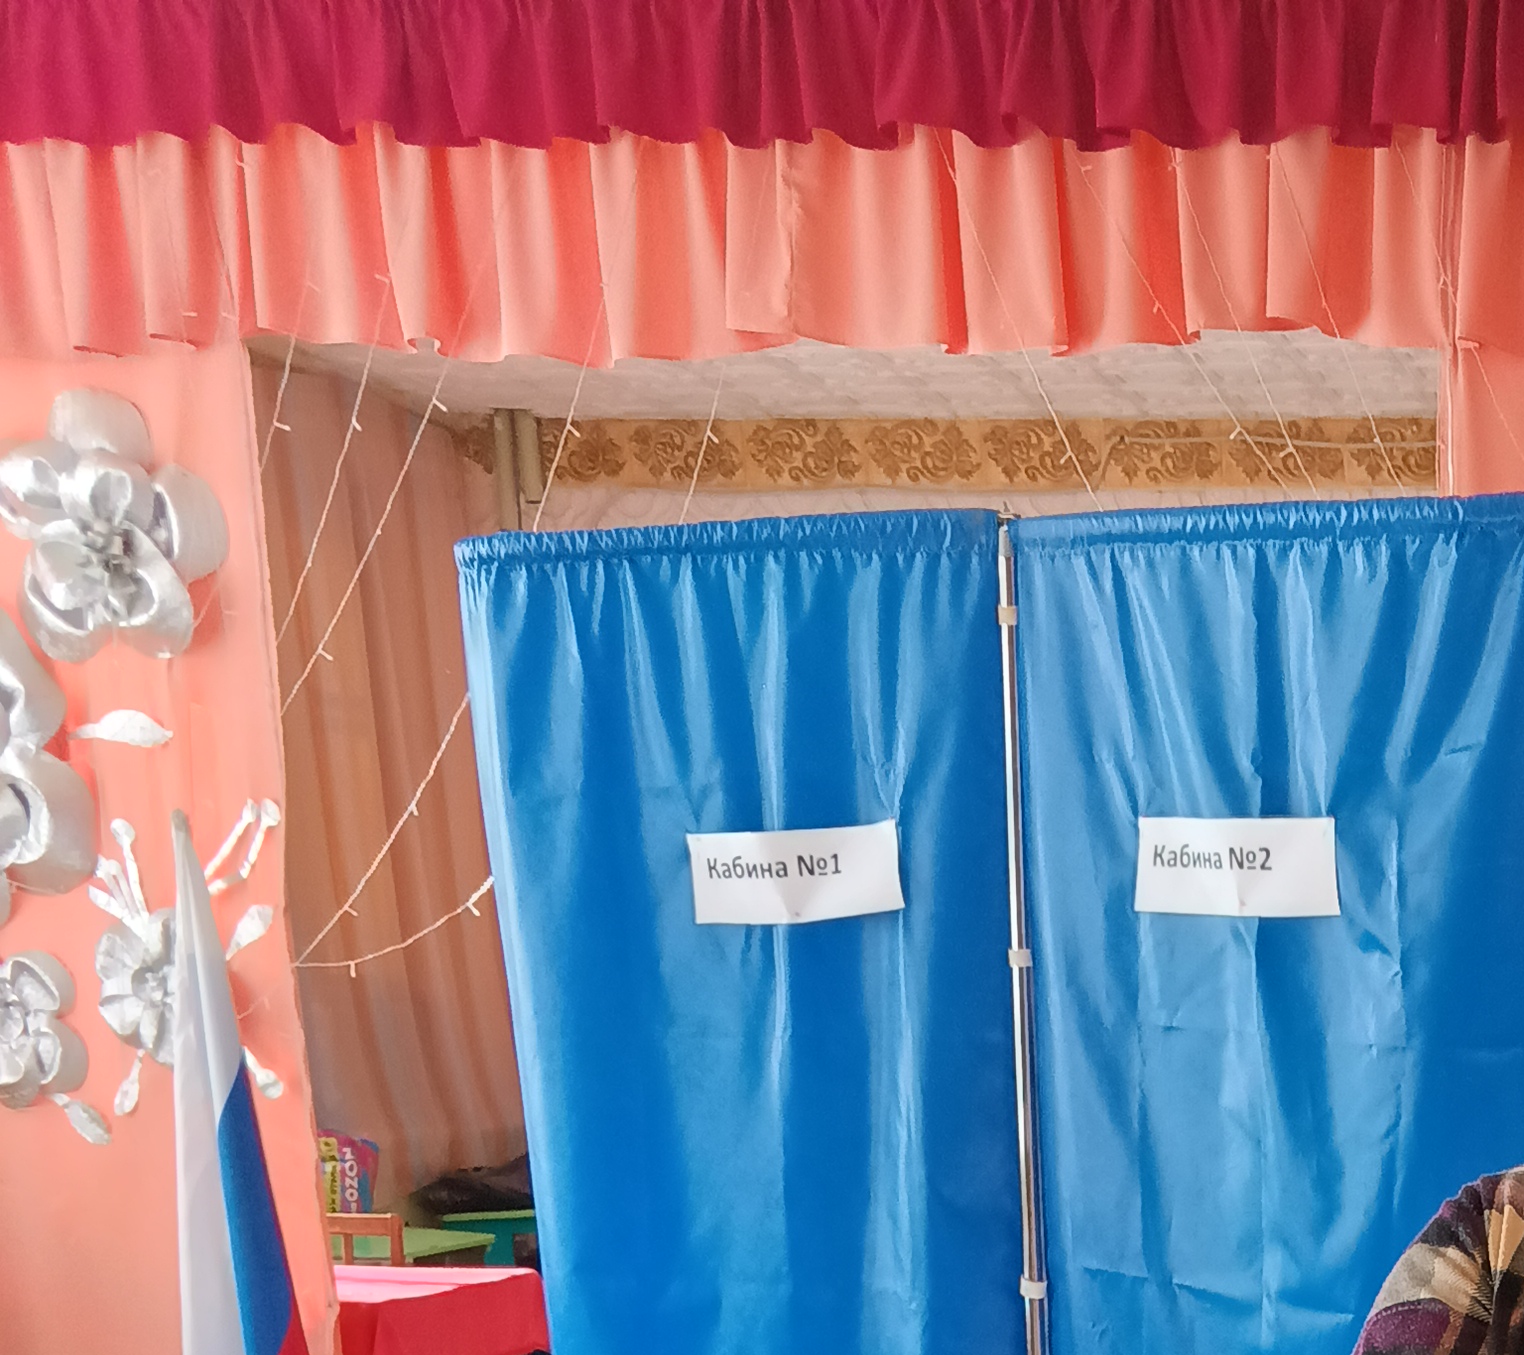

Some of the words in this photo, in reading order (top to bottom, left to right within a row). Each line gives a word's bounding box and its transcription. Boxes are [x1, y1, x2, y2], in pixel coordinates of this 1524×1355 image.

[706, 855, 789, 880] Кабина
[797, 853, 842, 877] №1
[1153, 843, 1223, 870] Кабина
[1229, 846, 1273, 871] №2
